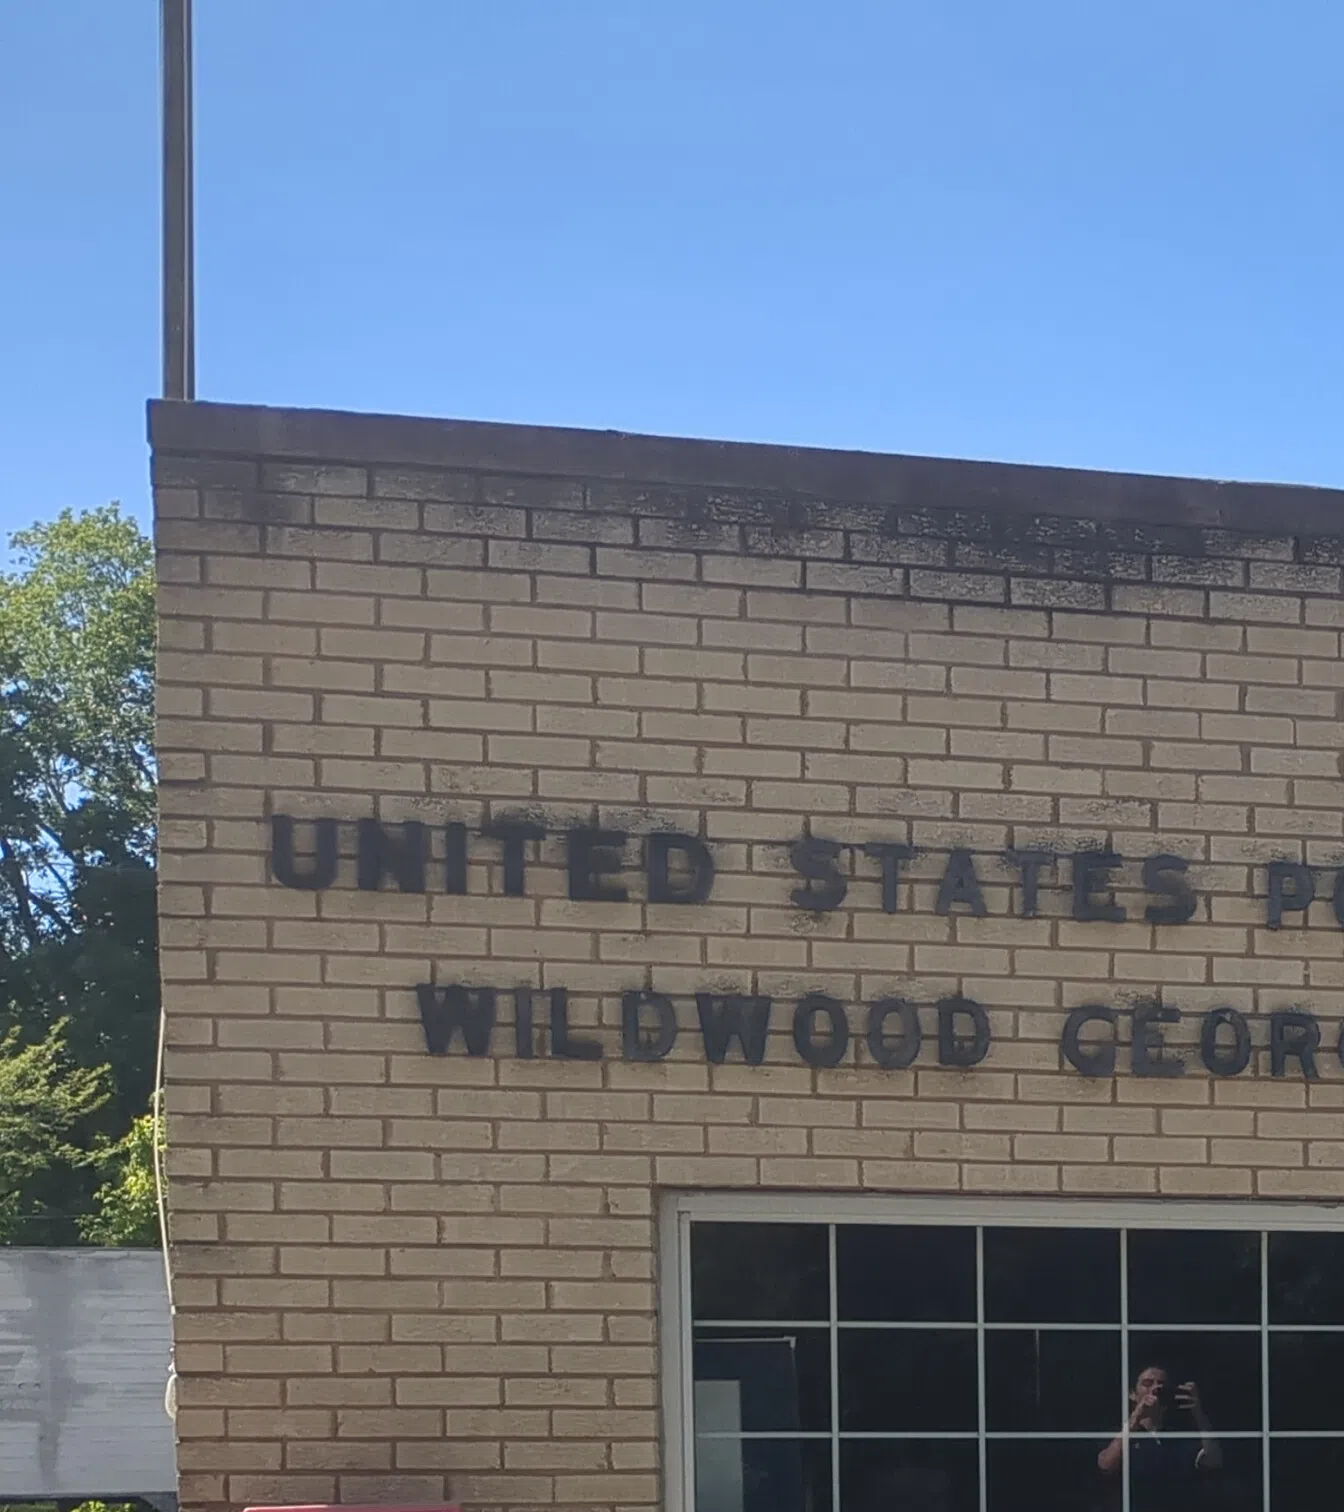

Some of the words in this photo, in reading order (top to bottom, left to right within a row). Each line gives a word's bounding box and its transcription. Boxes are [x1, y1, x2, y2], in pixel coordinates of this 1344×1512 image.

[272, 814, 716, 906] UNITED
[789, 836, 1197, 927] STATES
[416, 982, 993, 1068] WILDWOOD
